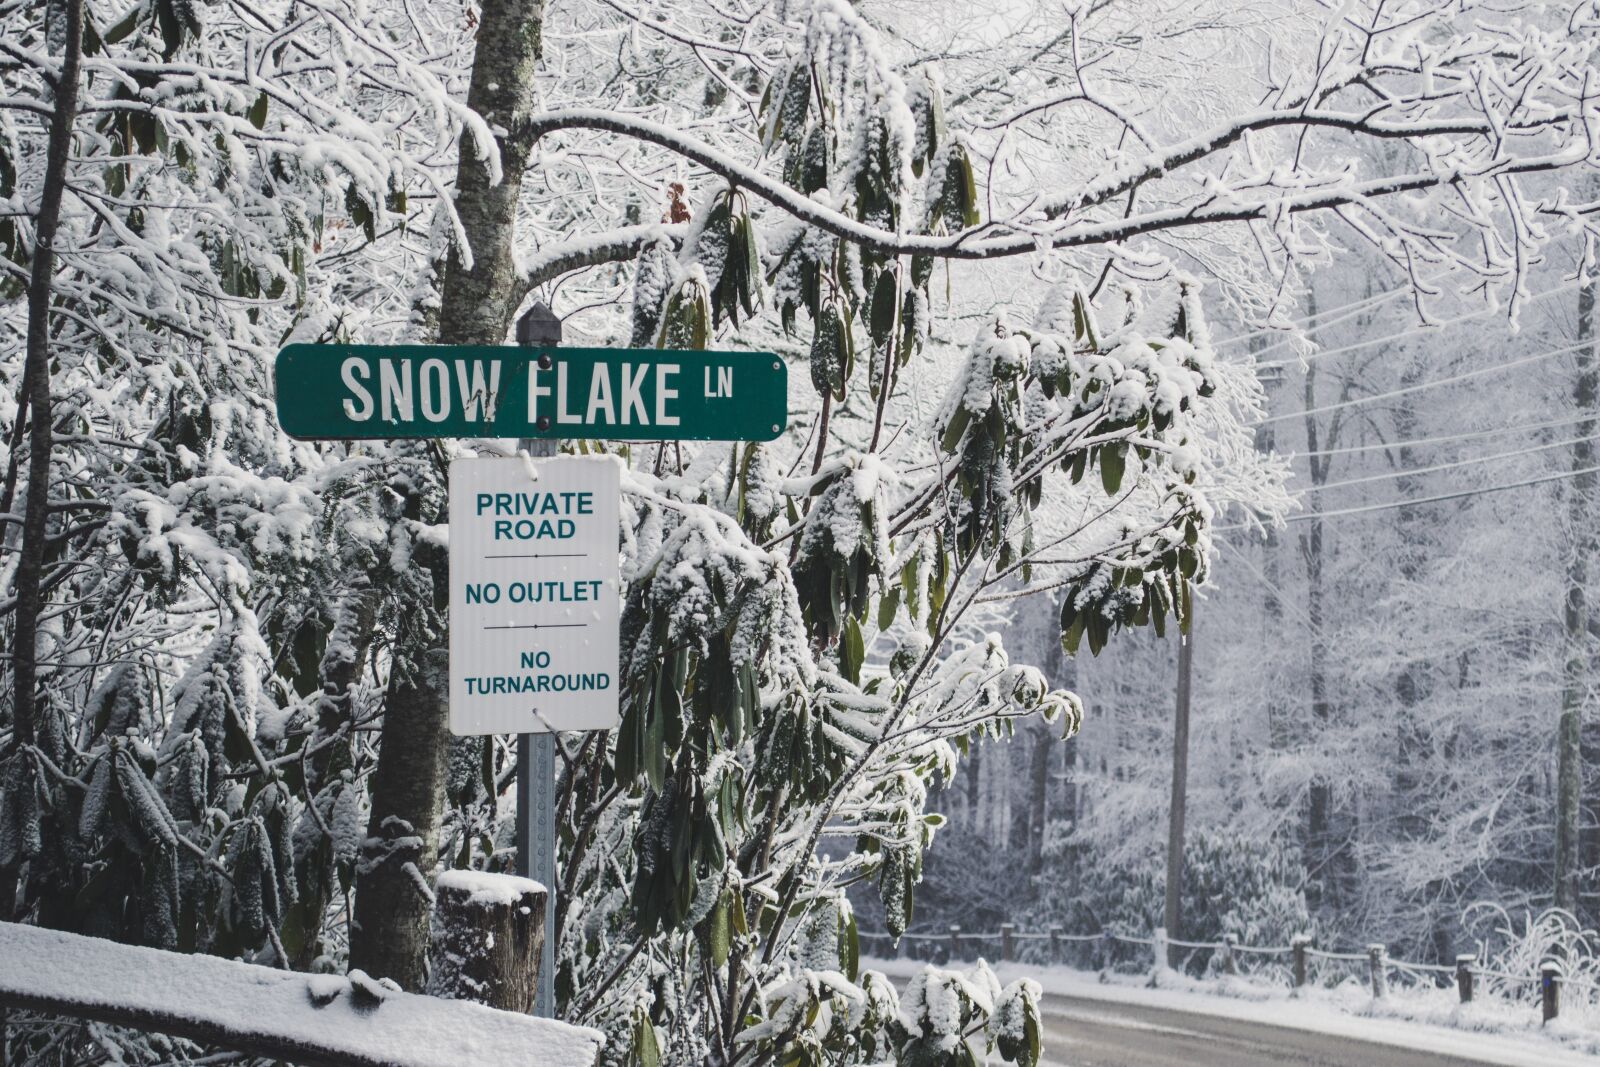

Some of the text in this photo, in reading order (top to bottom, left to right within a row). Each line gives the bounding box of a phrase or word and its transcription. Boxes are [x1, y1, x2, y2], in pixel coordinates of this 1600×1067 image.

[340, 357, 733, 426] SNOW FLAKE LN
[477, 492, 593, 516] PRIVATE
[494, 519, 576, 540] ROAD
[465, 580, 603, 604] NO OUTLET
[520, 651, 551, 669] NO
[464, 673, 610, 695] TURNAROUND
